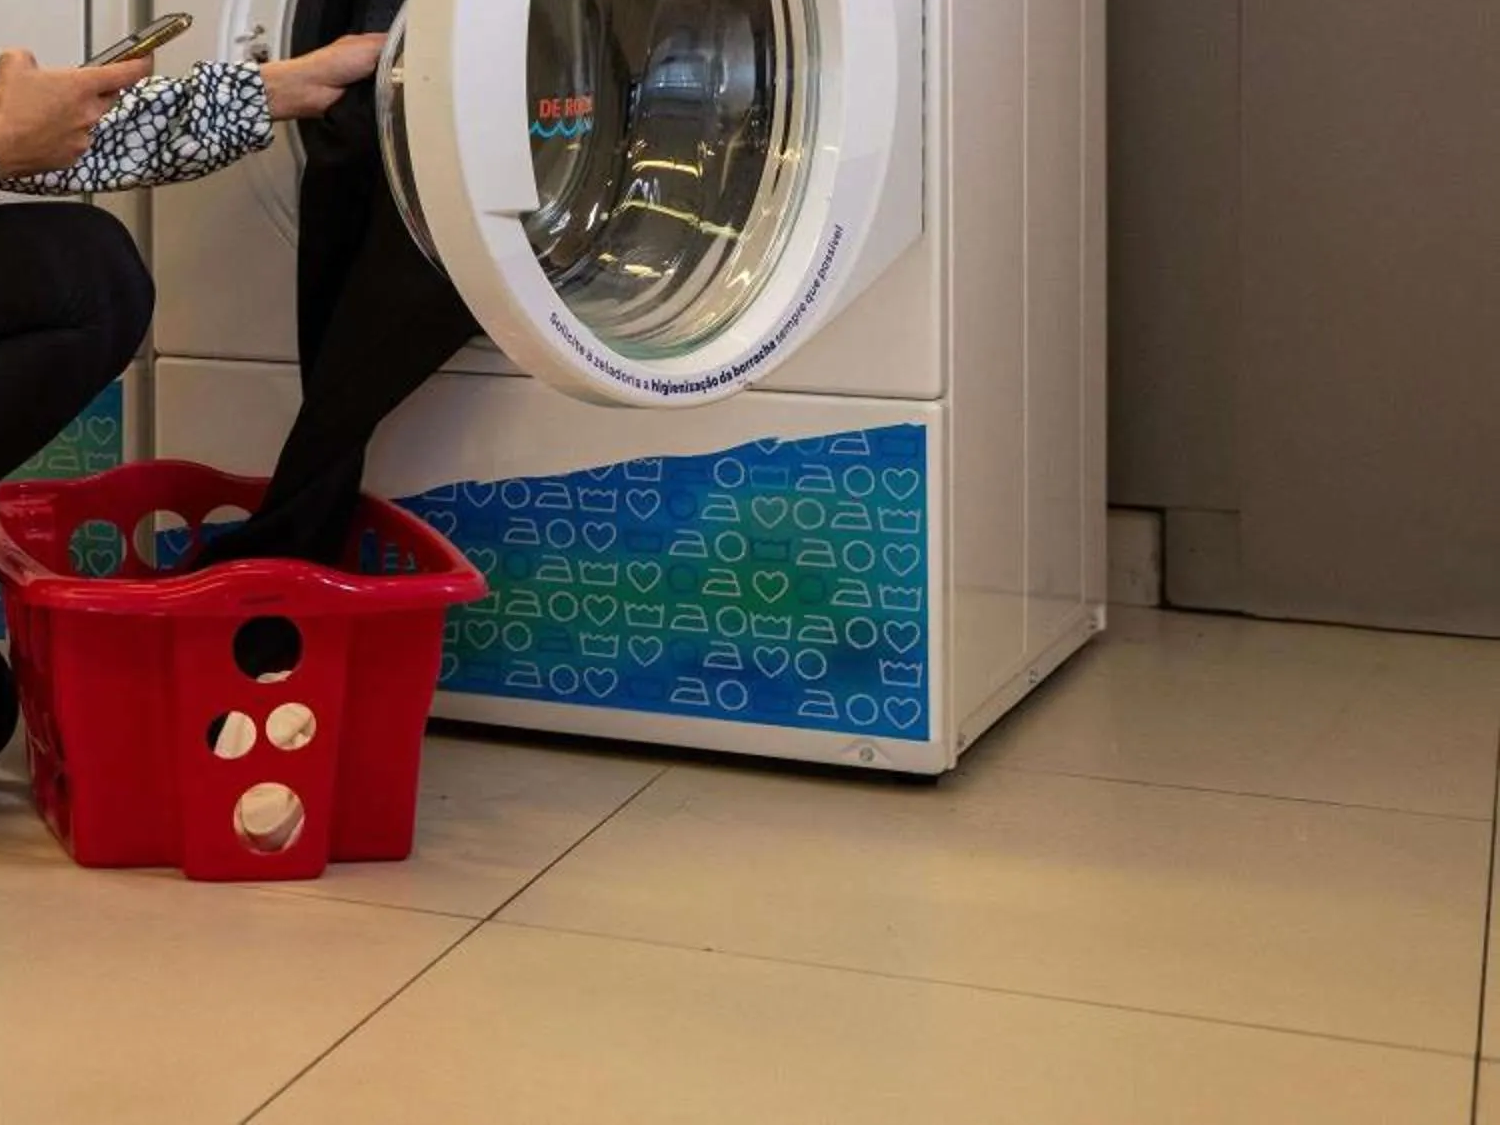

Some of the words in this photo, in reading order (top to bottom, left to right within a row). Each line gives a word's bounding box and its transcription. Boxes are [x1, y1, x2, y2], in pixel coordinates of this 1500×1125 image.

[539, 98, 562, 118] DE
[549, 312, 586, 356] Solicite
[593, 357, 642, 389] zeladoria
[642, 380, 650, 390] a
[651, 375, 719, 396] higienização
[719, 370, 733, 384] da
[732, 340, 777, 378] borracha
[775, 302, 807, 345] sempre
[805, 278, 821, 305] que
[817, 224, 844, 282] possível
